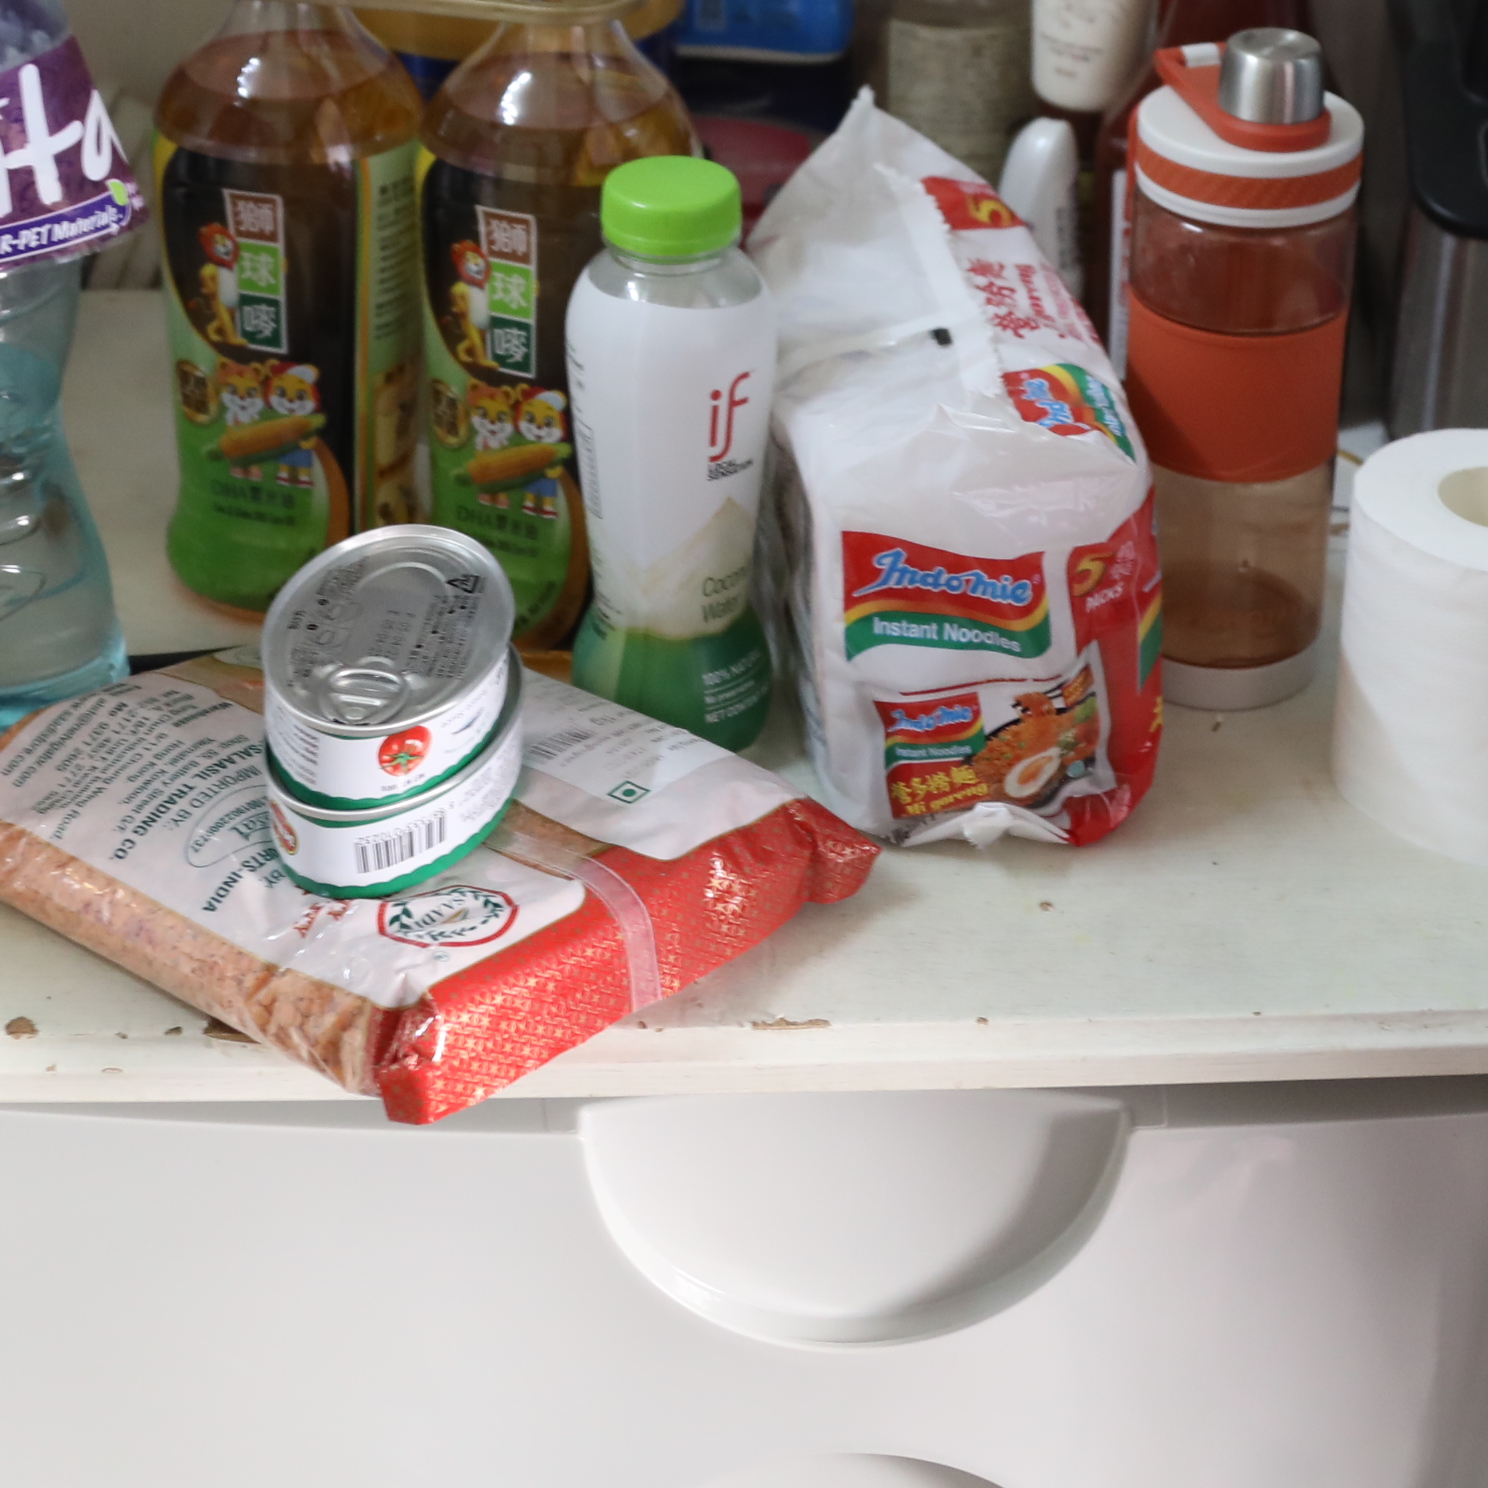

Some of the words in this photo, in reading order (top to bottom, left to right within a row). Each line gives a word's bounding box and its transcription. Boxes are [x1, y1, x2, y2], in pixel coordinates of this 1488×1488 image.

[233, 196, 280, 346] 獅球嘜
[486, 215, 532, 365] 獅球嘜
[851, 548, 1035, 609] Indomie
[1070, 553, 1113, 599] 5
[872, 616, 939, 644] Instant
[940, 622, 1022, 656] Noodles
[153, 738, 186, 763] Hong
[132, 787, 165, 816] Street
[132, 781, 196, 838] TRADING
[189, 764, 261, 812] IMPORTED
[108, 837, 138, 866] CO.
